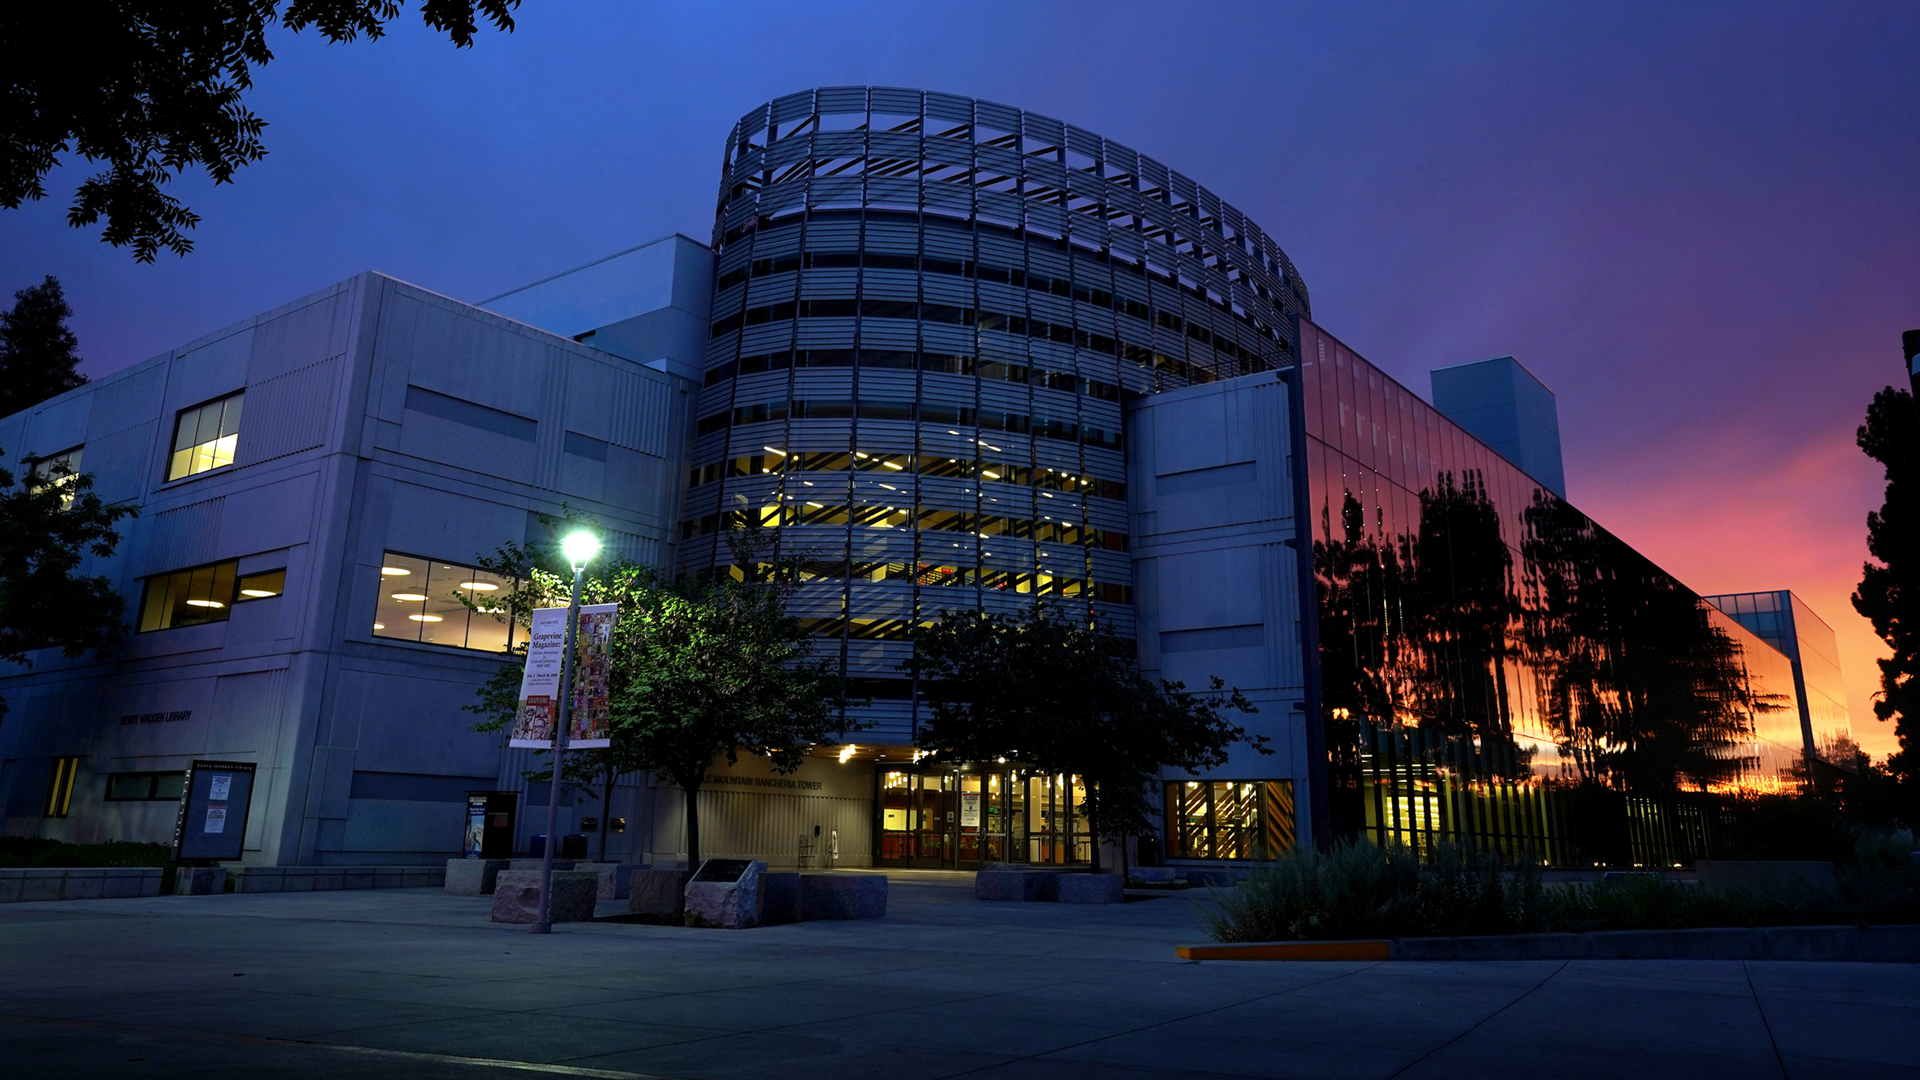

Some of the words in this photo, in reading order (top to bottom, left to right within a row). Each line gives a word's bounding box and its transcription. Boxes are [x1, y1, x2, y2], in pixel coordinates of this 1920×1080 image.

[533, 632, 562, 641] Grapevine
[532, 641, 561, 650] Magazine:
[120, 714, 140, 725] HENRY
[140, 712, 165, 724] MADDEN
[165, 710, 192, 722] LIBRARY
[235, 764, 254, 772] library
[714, 774, 753, 786] MOUNTAIN
[754, 777, 796, 789] RANCHERIA
[797, 780, 822, 791] TOWER
